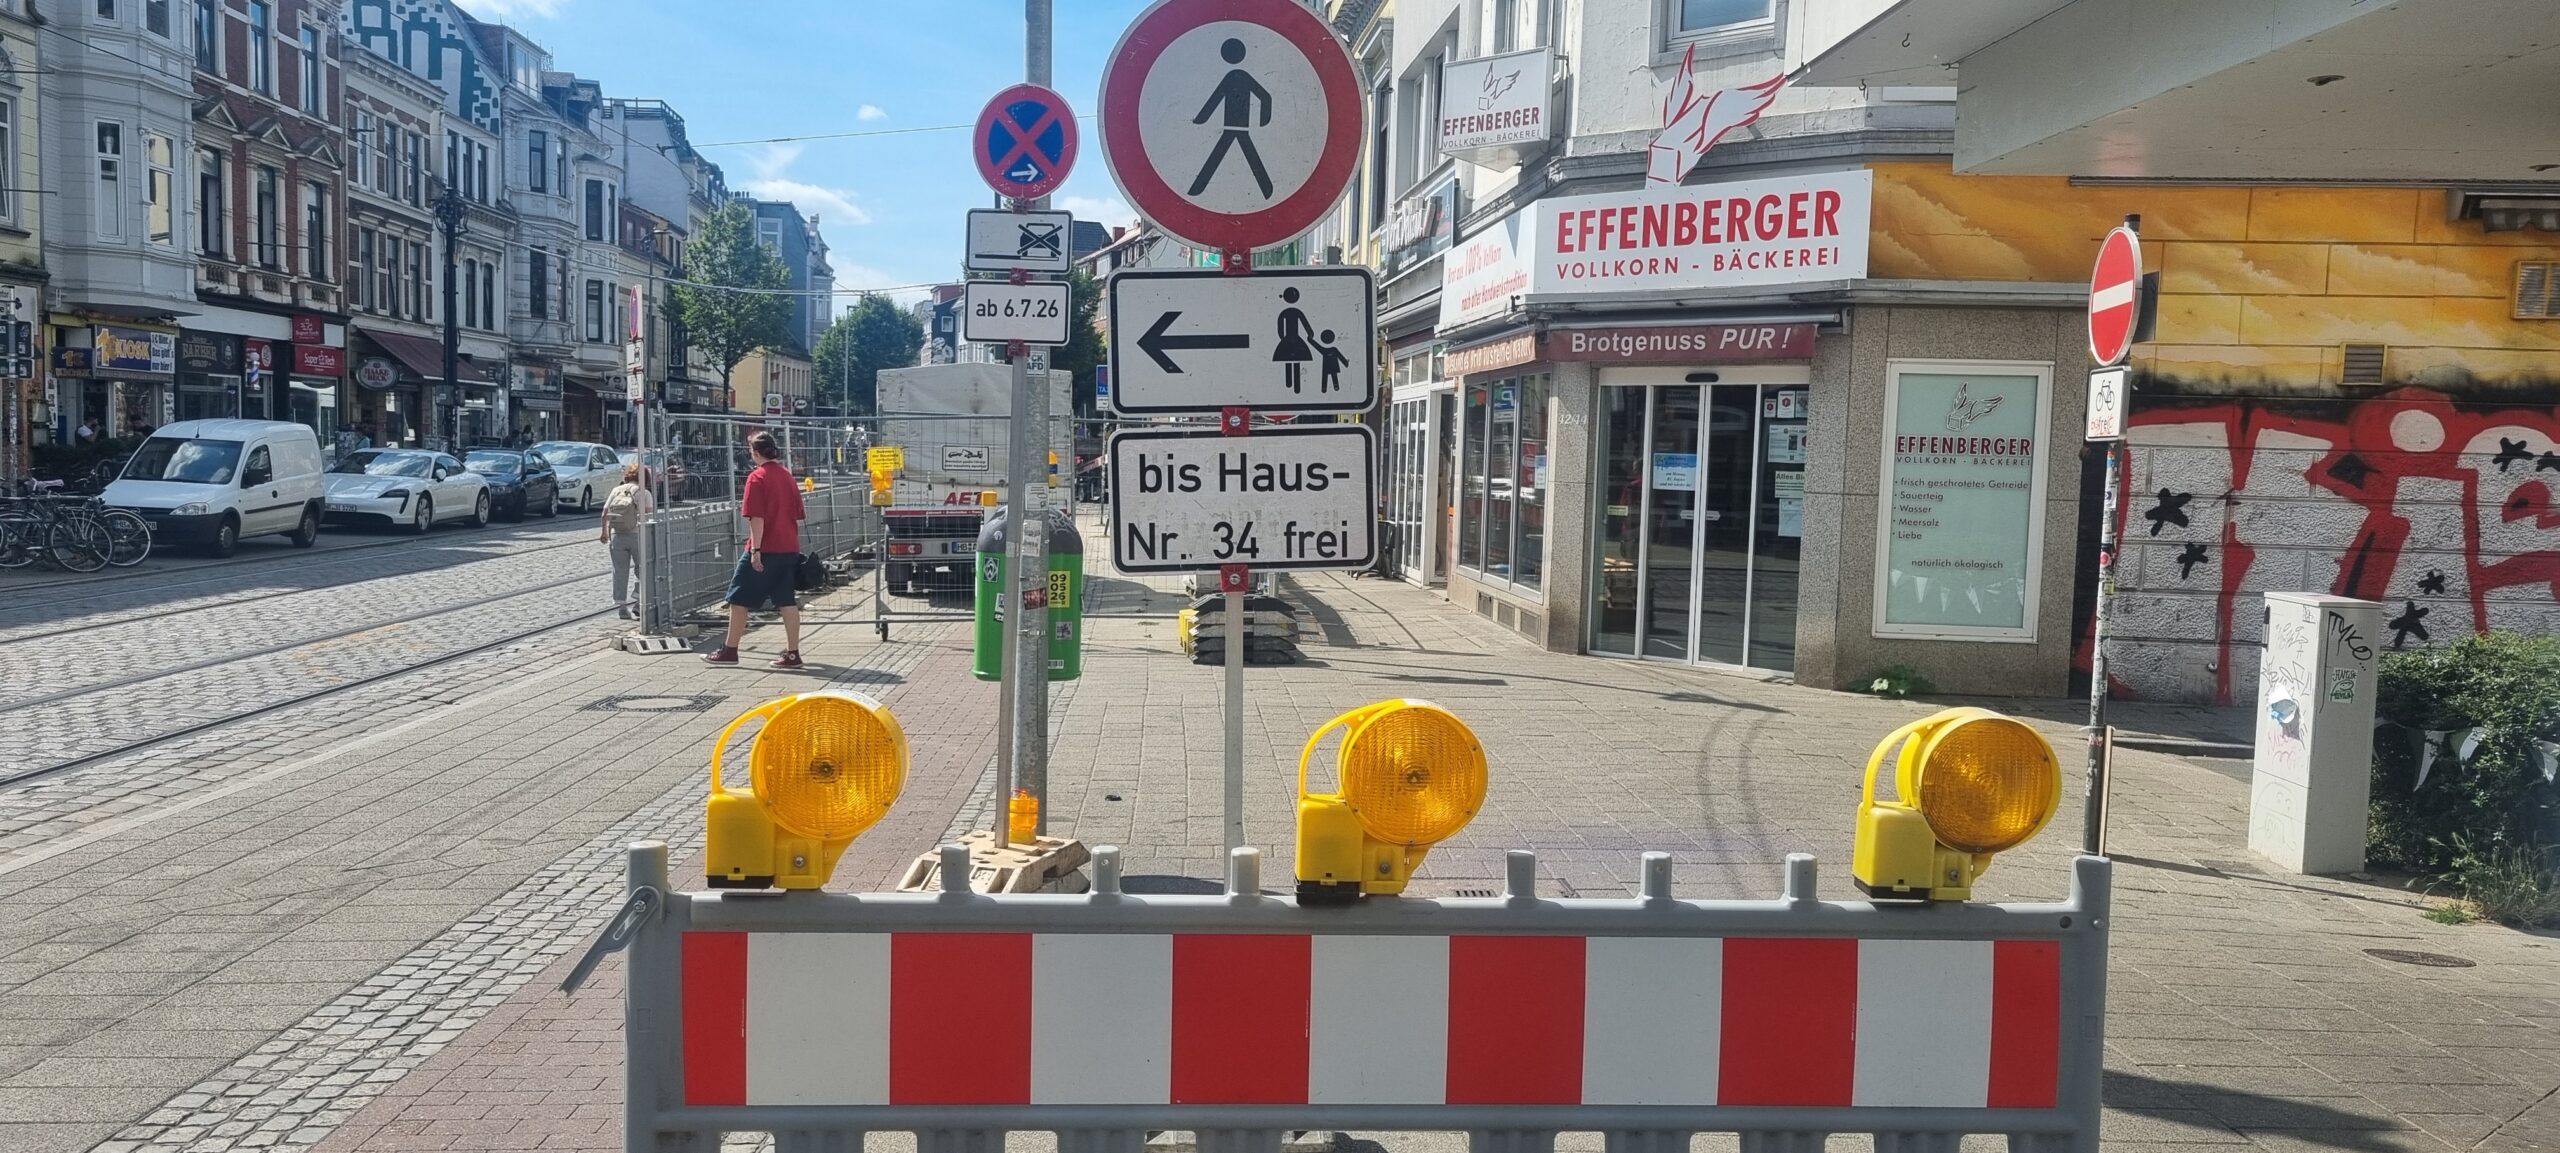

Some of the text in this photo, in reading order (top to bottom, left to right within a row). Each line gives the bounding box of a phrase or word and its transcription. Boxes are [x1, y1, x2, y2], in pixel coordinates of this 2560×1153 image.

[1443, 107, 1540, 136] EFFENBERGER
[1443, 136, 1487, 148] VOLLKORN
[1557, 190, 1841, 253] EFFENBERGER
[1465, 242, 1482, 276] 100%
[1557, 256, 1679, 280] VOLLKORN
[1714, 246, 1840, 273] BÄCKEREI
[976, 298, 1059, 318] ab 6.7.26
[1571, 330, 1706, 357] Brotgenuss
[1719, 328, 1773, 350] PUR
[116, 338, 150, 360] KIOSK
[182, 343, 217, 361] BARBER
[304, 353, 318, 364] Super
[1027, 362, 1044, 371] AFD
[1896, 436, 2031, 456] EFFENBERGER
[1896, 456, 1957, 464] VOLLKORN
[1139, 452, 1350, 494] bis Haus-
[1900, 478, 2029, 489] frisch geschrotetes Getreide
[1900, 491, 1944, 501] Sauerteig
[1900, 505, 1932, 513] Wasser
[1898, 518, 1940, 527] Meersalz
[1212, 521, 1260, 559] 34
[1284, 520, 1348, 559] frei
[1898, 531, 1922, 540] Liebe
[1911, 558, 2004, 570] natürlich ökologisch
[1050, 574, 1067, 582] 09
[1050, 583, 1066, 591] 05
[1050, 592, 1066, 601] 26
